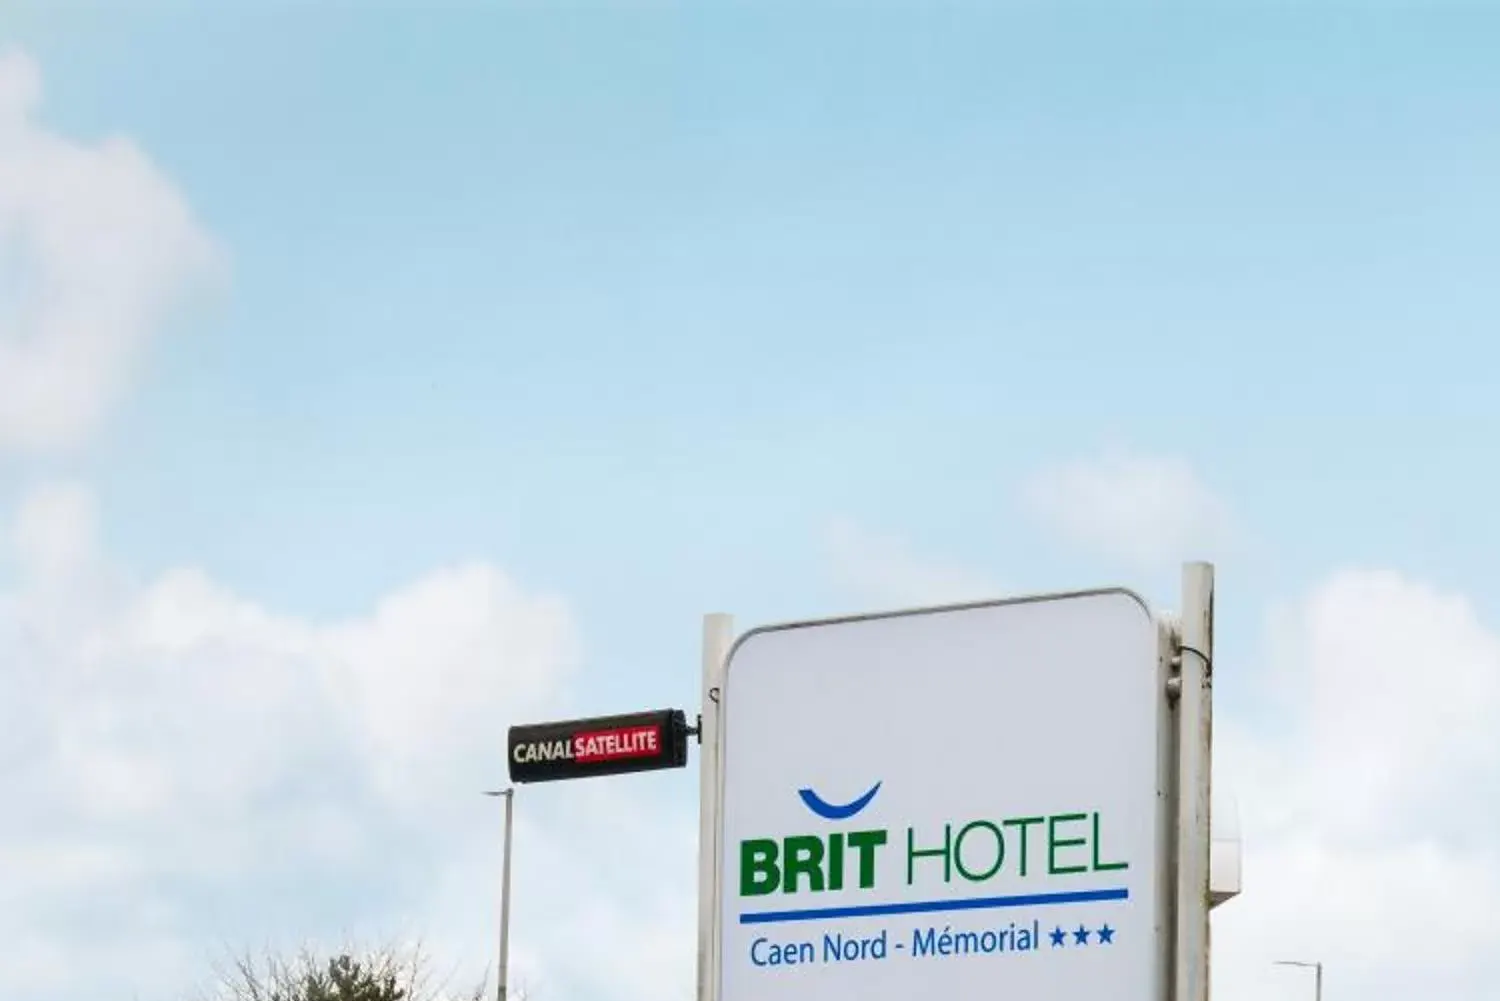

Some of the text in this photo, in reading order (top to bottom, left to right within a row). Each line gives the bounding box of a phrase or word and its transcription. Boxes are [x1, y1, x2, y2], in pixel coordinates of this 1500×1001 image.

[739, 811, 1129, 896] BRIT HOTEL
[750, 937, 815, 966] Caen
[823, 930, 887, 963] Nord
[912, 919, 1039, 957] Mémorial
